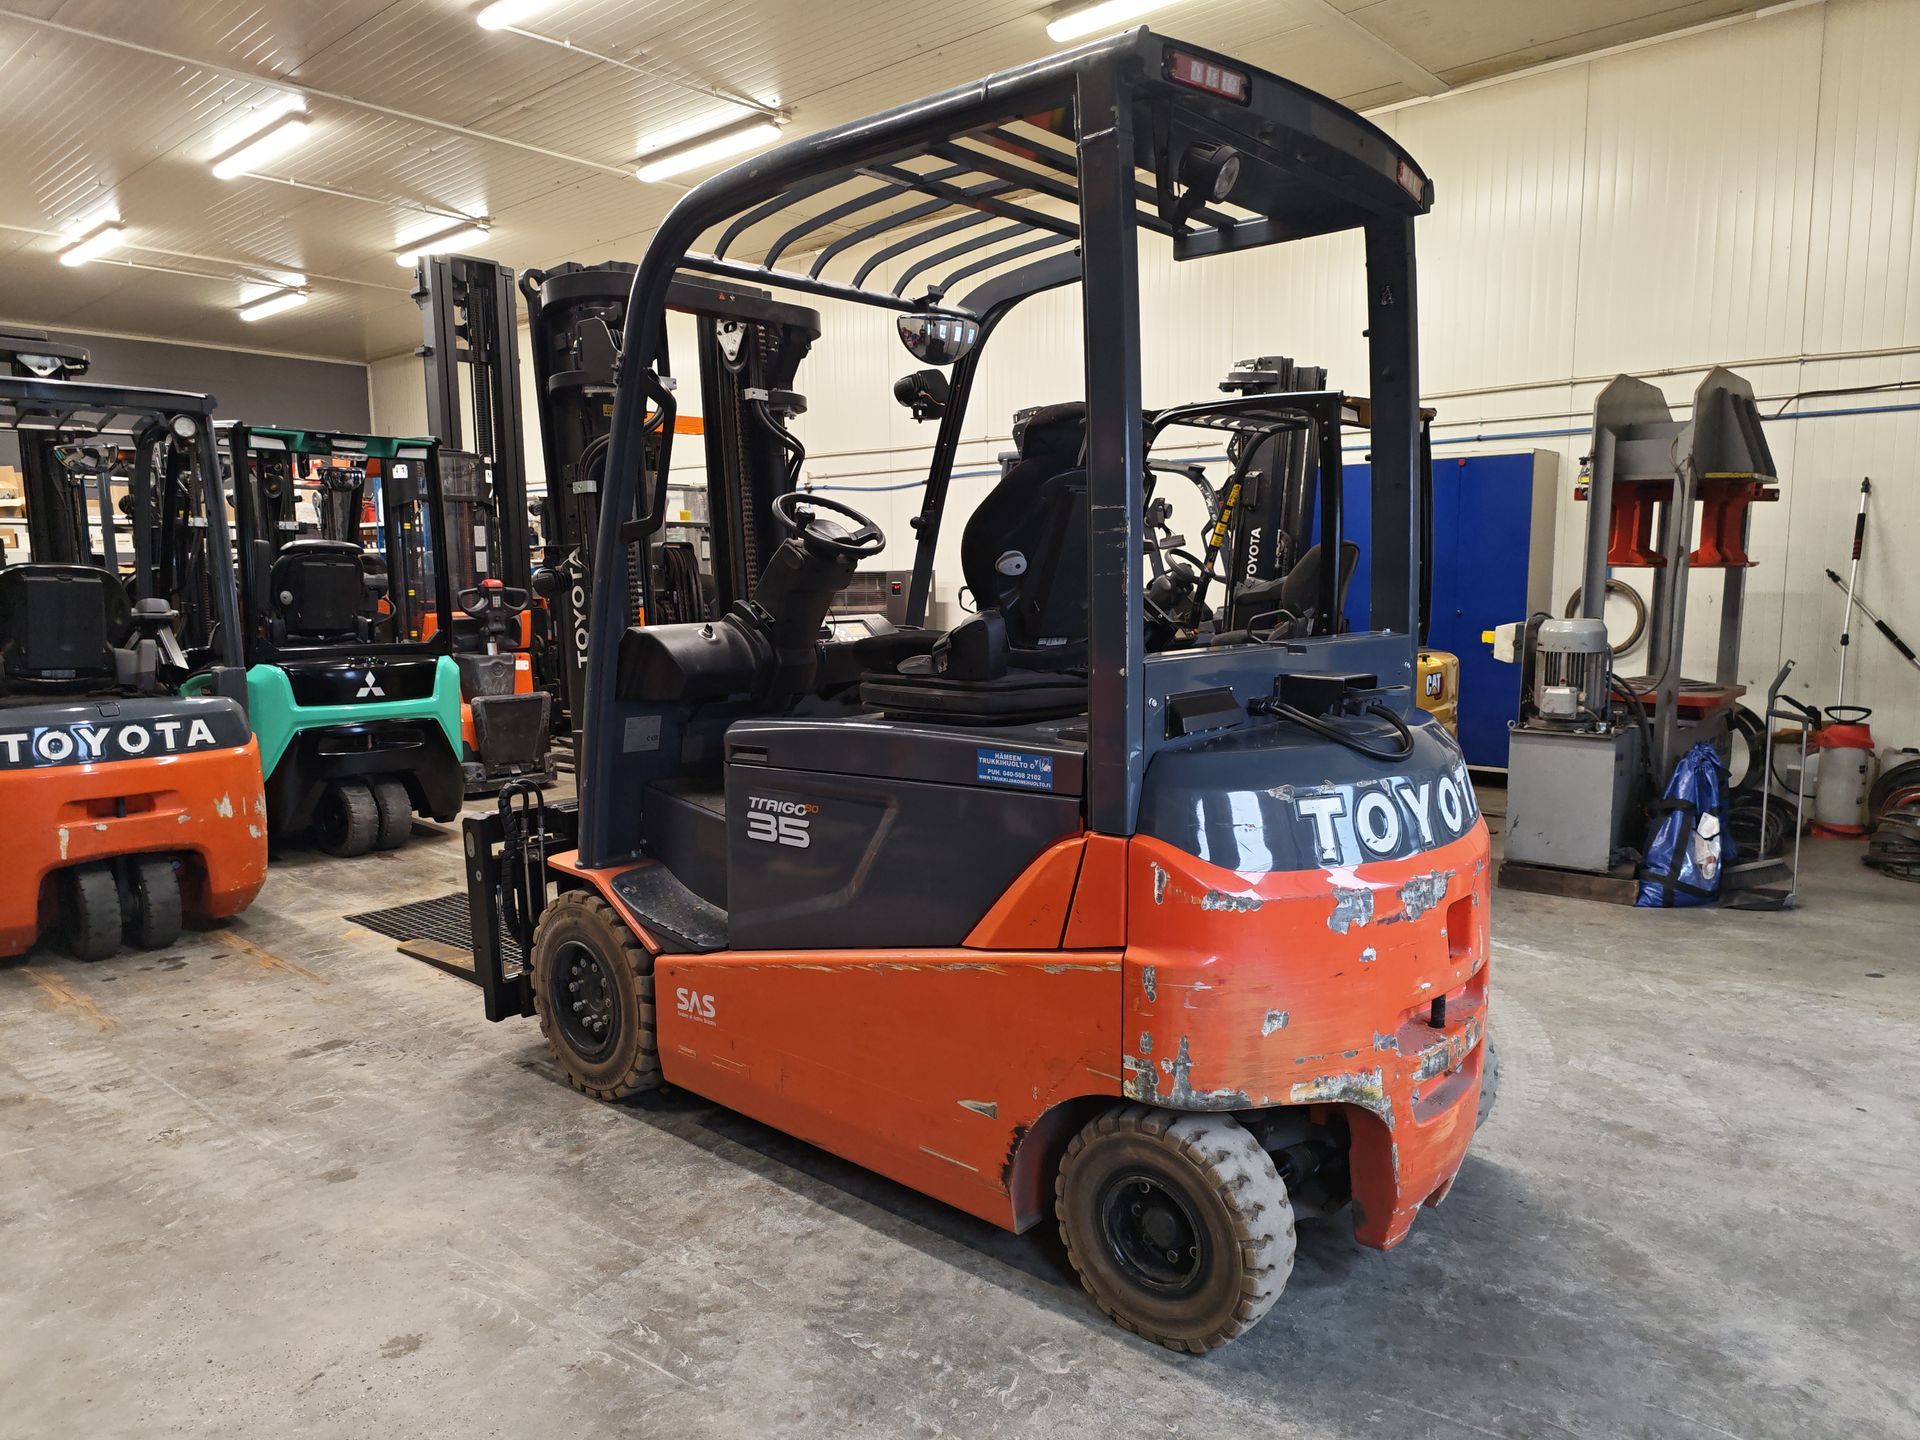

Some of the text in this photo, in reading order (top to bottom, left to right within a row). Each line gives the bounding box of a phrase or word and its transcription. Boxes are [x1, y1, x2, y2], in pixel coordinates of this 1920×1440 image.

[569, 546, 589, 669] TOYOTA
[1426, 673, 1442, 696] CAT
[0, 719, 216, 763] TOYOTA
[979, 757, 1028, 769] TRUKKIHUOLTO
[987, 768, 1001, 776] PUH.
[995, 752, 1022, 762] HÄMEEN
[1298, 765, 1475, 860] TOYOT
[746, 811, 811, 849] 35
[676, 987, 716, 1018] SAS
